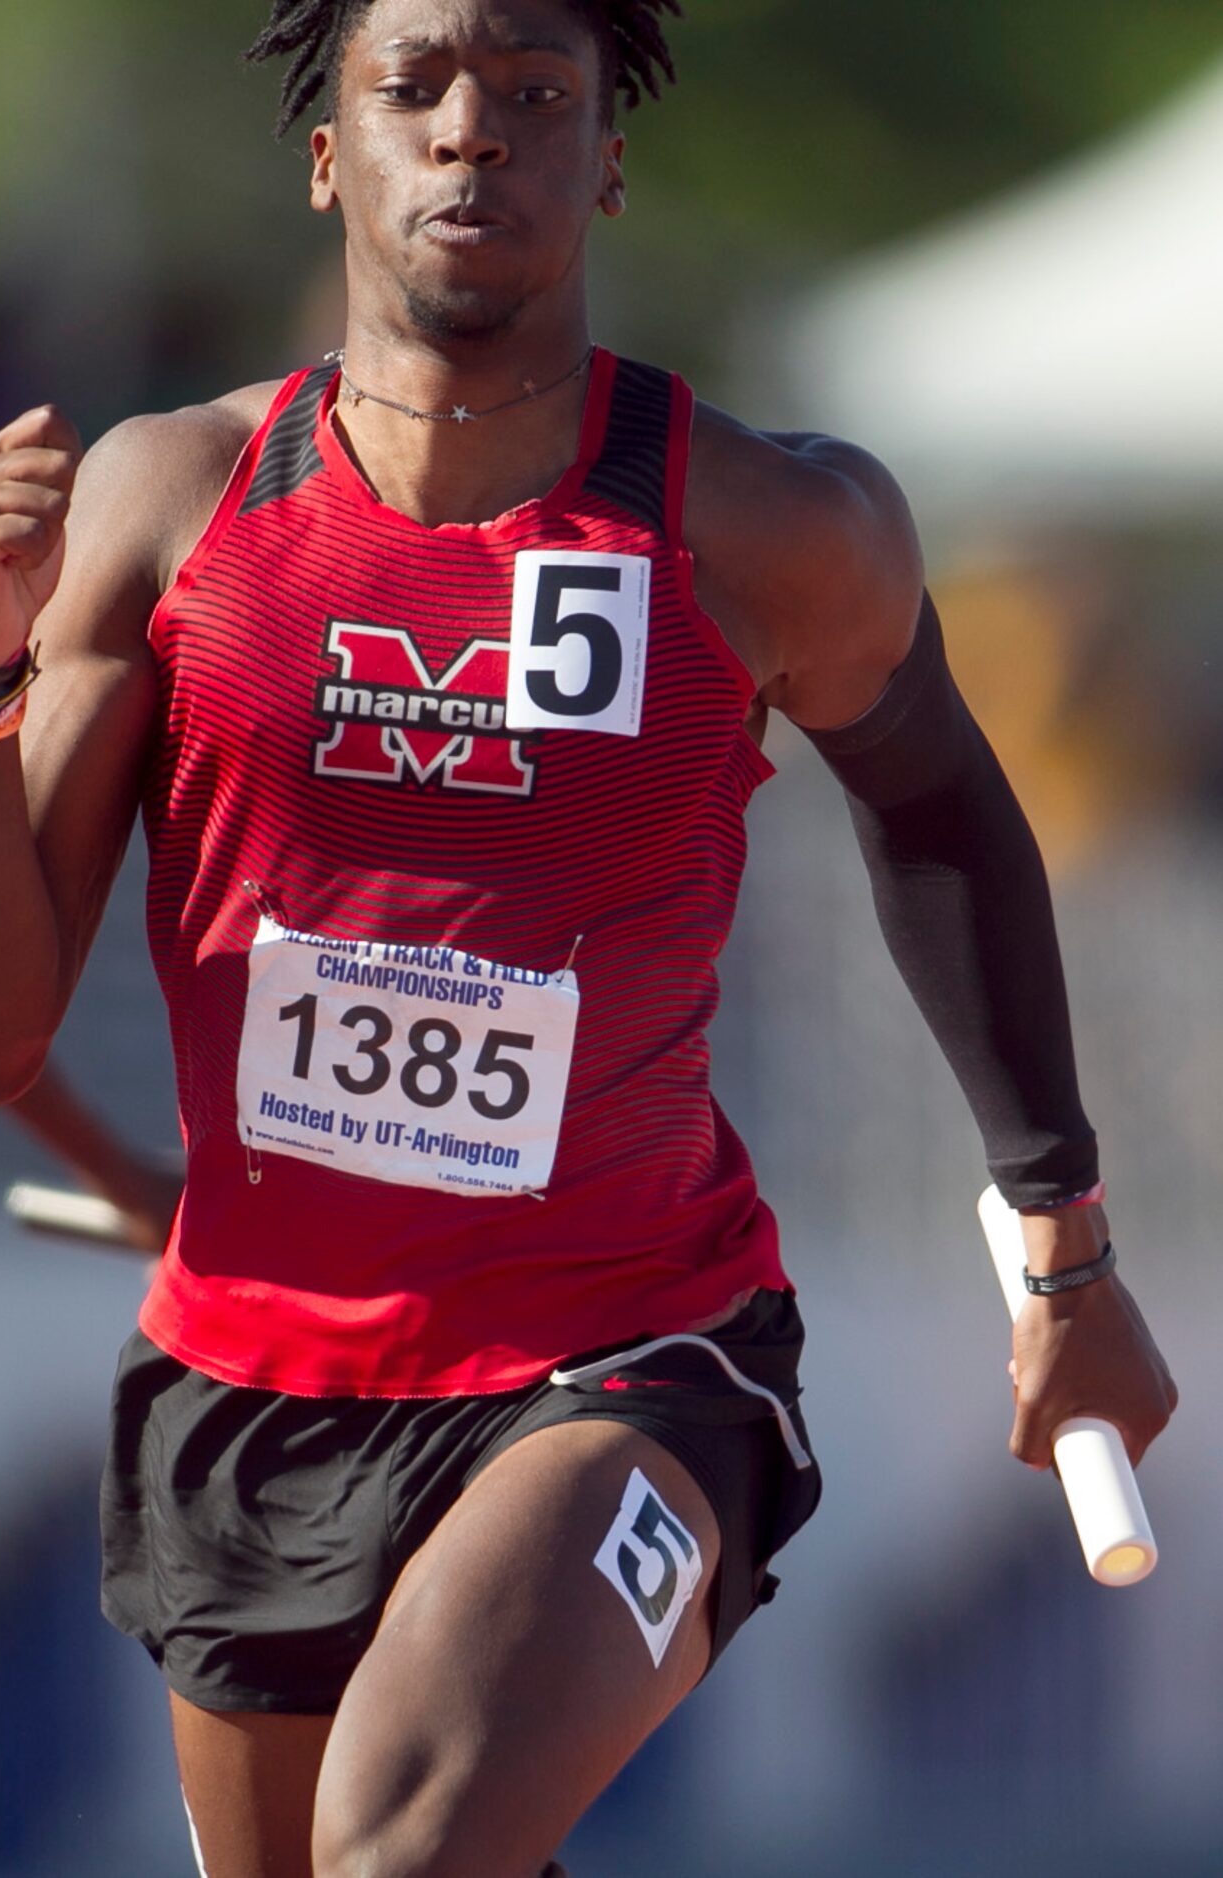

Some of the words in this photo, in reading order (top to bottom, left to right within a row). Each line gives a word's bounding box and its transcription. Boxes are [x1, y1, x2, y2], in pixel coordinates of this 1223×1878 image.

[525, 564, 622, 717] 5
[323, 684, 507, 731] marcu
[316, 953, 504, 1010] CHAMPIONSHIPS
[383, 944, 454, 972] TRACK
[463, 953, 481, 976] &
[279, 993, 534, 1120] 1385
[260, 1091, 334, 1133] Hosted
[341, 1112, 368, 1144] by
[376, 1119, 520, 1169] UT-Arlington
[617, 1491, 694, 1626] 5
